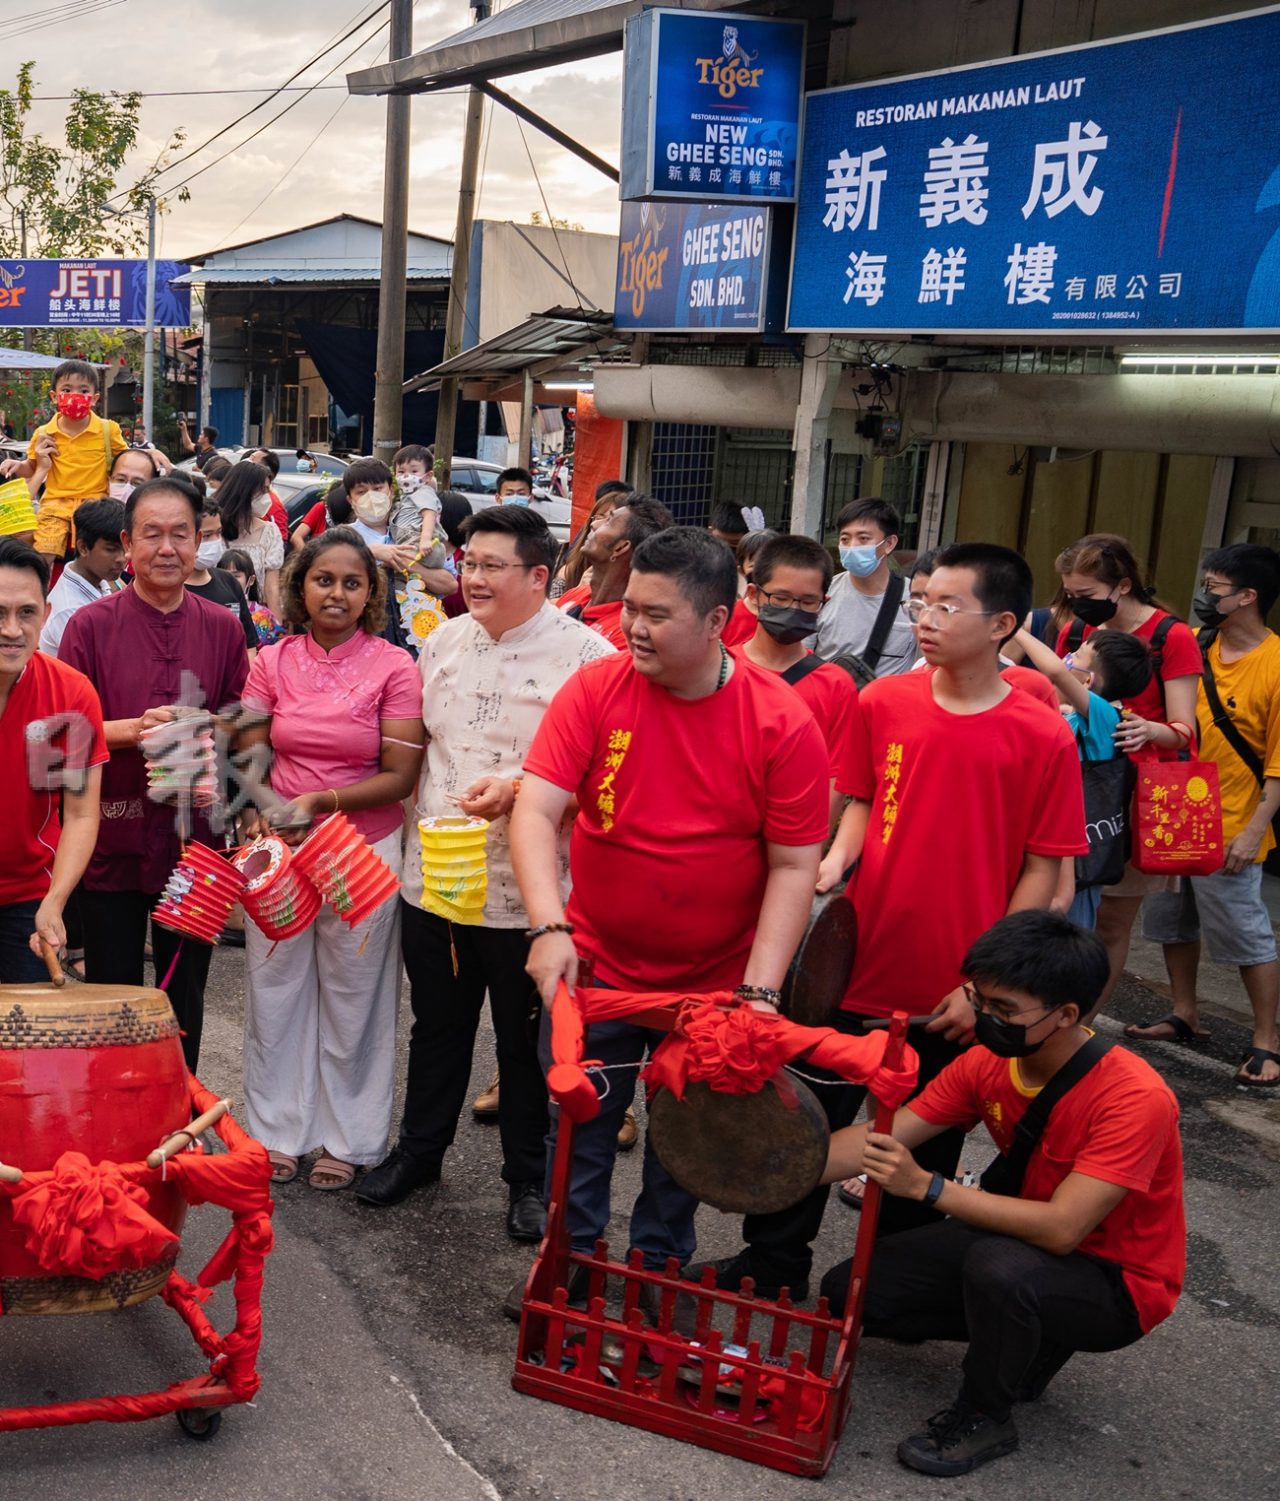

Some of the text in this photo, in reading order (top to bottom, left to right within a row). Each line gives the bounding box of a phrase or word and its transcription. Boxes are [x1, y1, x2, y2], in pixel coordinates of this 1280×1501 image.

[695, 56, 765, 98] Tiger
[690, 113, 720, 121] RESTORAN
[720, 115, 748, 123] MAKANAN
[855, 77, 1086, 128] RESTORAN MAKANAN LAUT
[705, 123, 748, 145] NEW
[666, 142, 767, 167] GHEE SENG
[767, 158, 784, 167] BHD.
[768, 150, 784, 159] SDN.
[668, 165, 782, 187] 新義成海鮮樓
[822, 119, 1109, 233] 新義成
[682, 215, 764, 267] GHEE SENG
[48, 269, 122, 298] JETI
[619, 229, 669, 319] Tiger
[843, 241, 1182, 307] 海鮮樓 有限公司
[689, 275, 746, 308] SDN. BHD.
